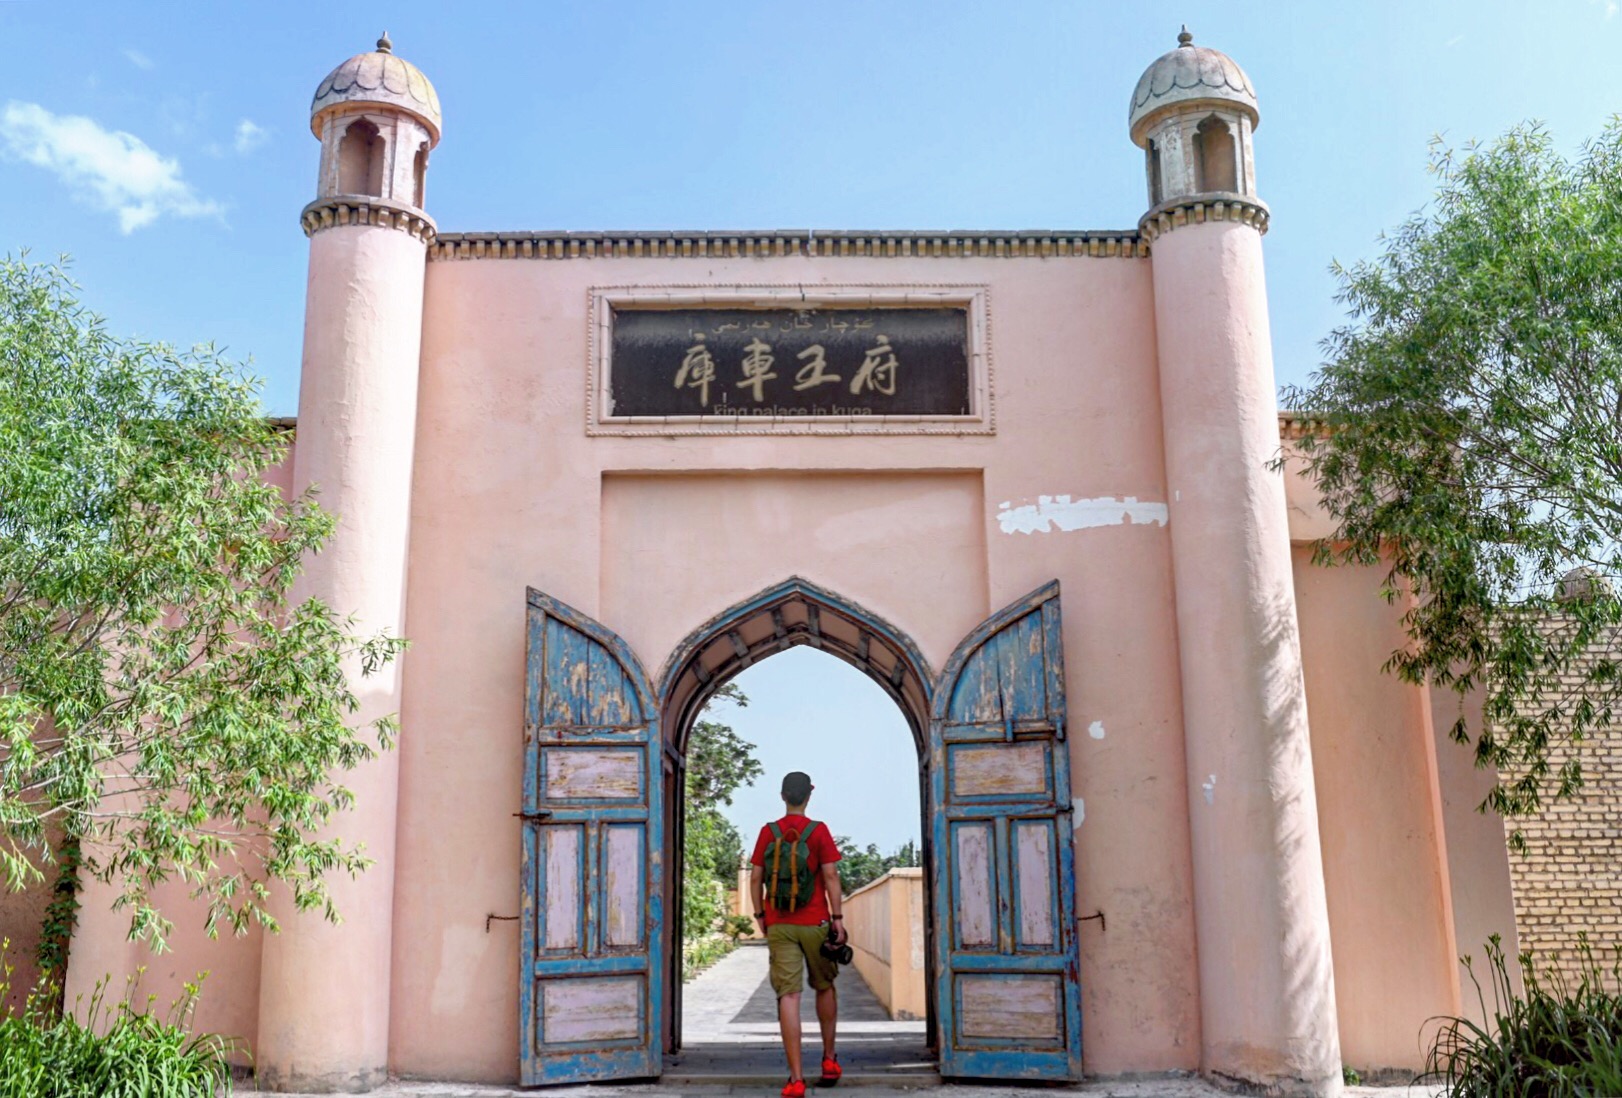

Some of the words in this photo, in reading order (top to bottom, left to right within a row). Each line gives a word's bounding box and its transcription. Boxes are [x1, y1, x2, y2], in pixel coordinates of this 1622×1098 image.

[673, 333, 899, 407] 庫車王府
[752, 403, 808, 416] palace
[812, 403, 827, 416] in
